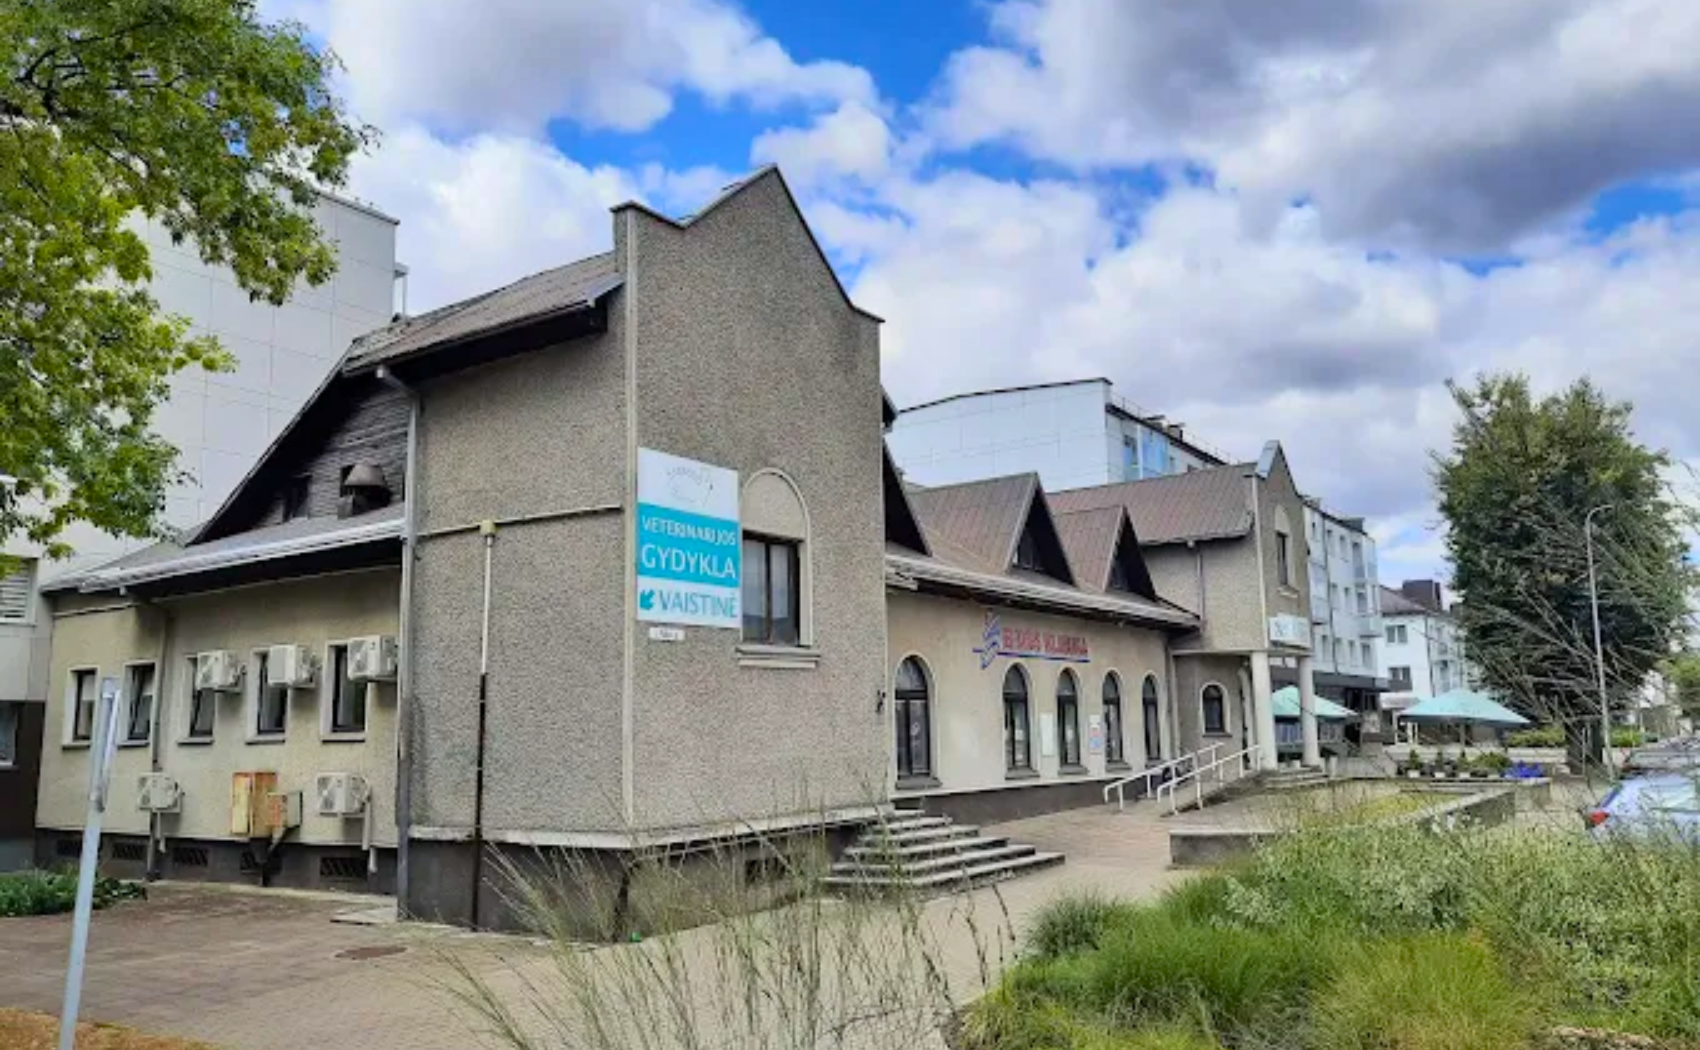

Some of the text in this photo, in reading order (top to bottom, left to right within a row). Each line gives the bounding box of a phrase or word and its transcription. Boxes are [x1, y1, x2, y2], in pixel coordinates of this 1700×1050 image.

[641, 514, 736, 546] VETERINARIJOS
[641, 543, 737, 579] GYDYKLA
[659, 588, 738, 619] VAISTINĖ
